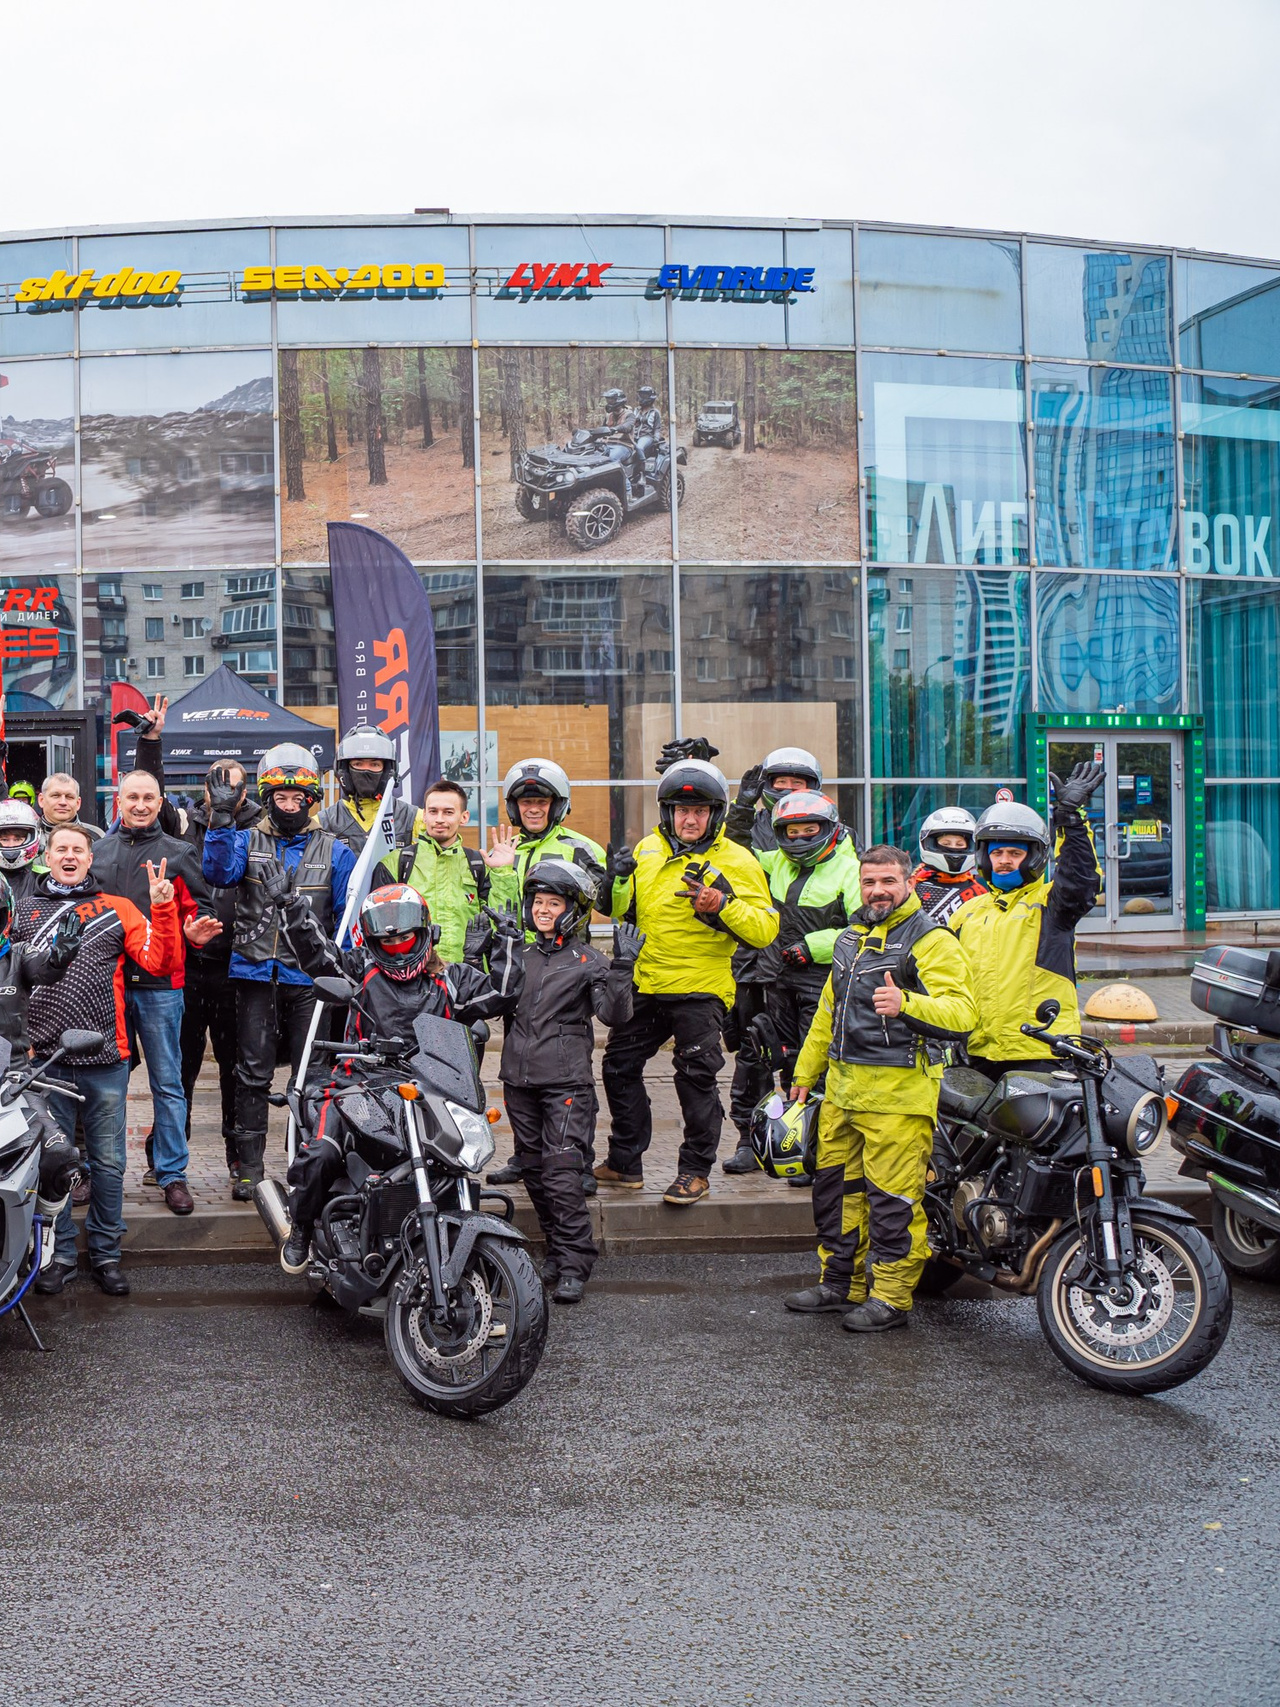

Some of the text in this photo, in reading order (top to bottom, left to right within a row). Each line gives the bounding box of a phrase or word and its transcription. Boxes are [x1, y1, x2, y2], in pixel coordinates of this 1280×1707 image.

[15, 266, 182, 303] ski-doo
[506, 262, 614, 291] LYNX
[657, 264, 816, 292] EVINRUDE
[17, 611, 59, 622] ДИЛЕР
[182, 708, 270, 720] VETERR
[234, 905, 275, 944] RUSSIA
[782, 1128, 797, 1149] SHOEI
